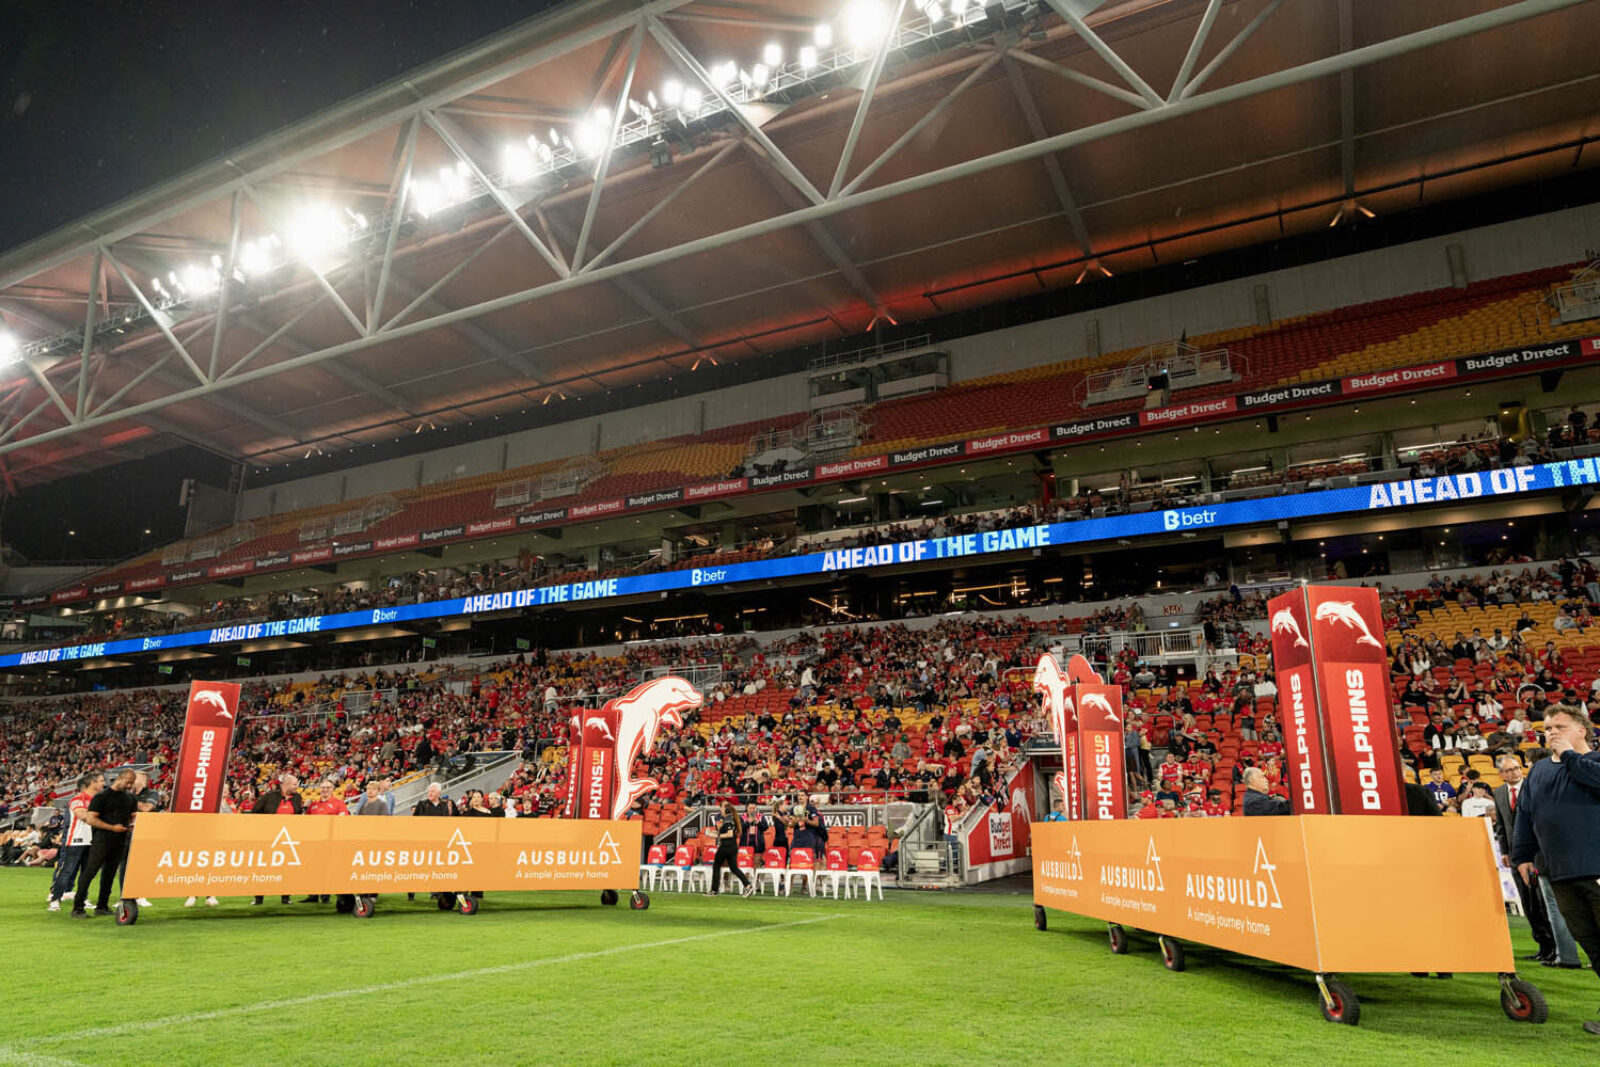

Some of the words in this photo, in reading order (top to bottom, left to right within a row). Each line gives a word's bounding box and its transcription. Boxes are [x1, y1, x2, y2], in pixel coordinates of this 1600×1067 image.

[1466, 353, 1520, 370] Budget
[1522, 344, 1570, 361] Direct
[1351, 372, 1400, 390] Budget
[1402, 364, 1446, 381] Direct
[1244, 390, 1290, 406] Budget
[1292, 384, 1332, 398] Direct
[1147, 406, 1189, 422] Budget
[1191, 400, 1227, 414] Direct
[1056, 420, 1094, 436] Budget
[1097, 416, 1131, 430] Direct
[972, 436, 1008, 450] Budget
[1010, 431, 1042, 444] Direct
[894, 450, 927, 462] Budget
[929, 444, 958, 456] Direct
[821, 464, 852, 475] Budget
[854, 458, 882, 470] Direct
[753, 474, 782, 486] Budget
[784, 470, 809, 480] Direct
[1369, 472, 1482, 509] AHEAD
[1490, 465, 1536, 494] OF
[1543, 457, 1600, 487] TH
[689, 484, 717, 496] Budget
[718, 480, 742, 491] Direct
[630, 495, 655, 506] Budget
[656, 491, 679, 501] Direct
[573, 504, 598, 516] Budget
[598, 501, 619, 511] Direct
[1182, 509, 1217, 526] betr
[822, 544, 894, 572] AHEAD
[900, 540, 928, 562] OF
[932, 534, 978, 558] THE
[982, 524, 1050, 552] GAME
[703, 570, 727, 582] betr
[463, 592, 512, 614] AHEAD
[516, 588, 535, 608] OF
[538, 584, 568, 604] THE
[572, 578, 618, 600] GAME
[381, 610, 398, 620] betr
[209, 625, 246, 644] AHEAD
[247, 622, 262, 638] OF
[264, 620, 286, 636] THE
[288, 616, 322, 634] GAME
[20, 649, 48, 665] AHEAD
[50, 648, 62, 662] OF
[62, 645, 79, 660] THE
[80, 643, 106, 658] GAME
[1094, 734, 1106, 752] UP
[1290, 673, 1315, 810] DOLPHINS
[1346, 669, 1382, 810] DOLPHINS
[592, 750, 601, 766] UP
[190, 730, 215, 810] DOLPHINS
[589, 766, 605, 818] PHINS
[1096, 754, 1114, 820] PHINS
[823, 814, 862, 827] WAHL
[990, 818, 1012, 836] Budget
[158, 850, 286, 868] AUSBUILD
[352, 850, 460, 866] AUSBUILD
[516, 850, 610, 866] AUSBUILD
[155, 874, 164, 884] A
[167, 874, 205, 885] simple
[206, 874, 250, 885] journey
[252, 872, 282, 882] home
[350, 872, 358, 880] A
[360, 871, 392, 882] simple
[394, 872, 430, 882] journey
[432, 870, 458, 880] home
[515, 870, 522, 878] A
[524, 870, 551, 880] simple
[552, 870, 584, 880] journey
[586, 869, 608, 878] home
[1042, 860, 1077, 880] AUSBUILD
[1100, 864, 1155, 892] AUSBUILD
[1186, 873, 1268, 908] AUSBUILD
[1187, 906, 1192, 920] A
[1194, 908, 1216, 925] simple
[1216, 912, 1245, 934] journey
[1246, 916, 1270, 936] home
